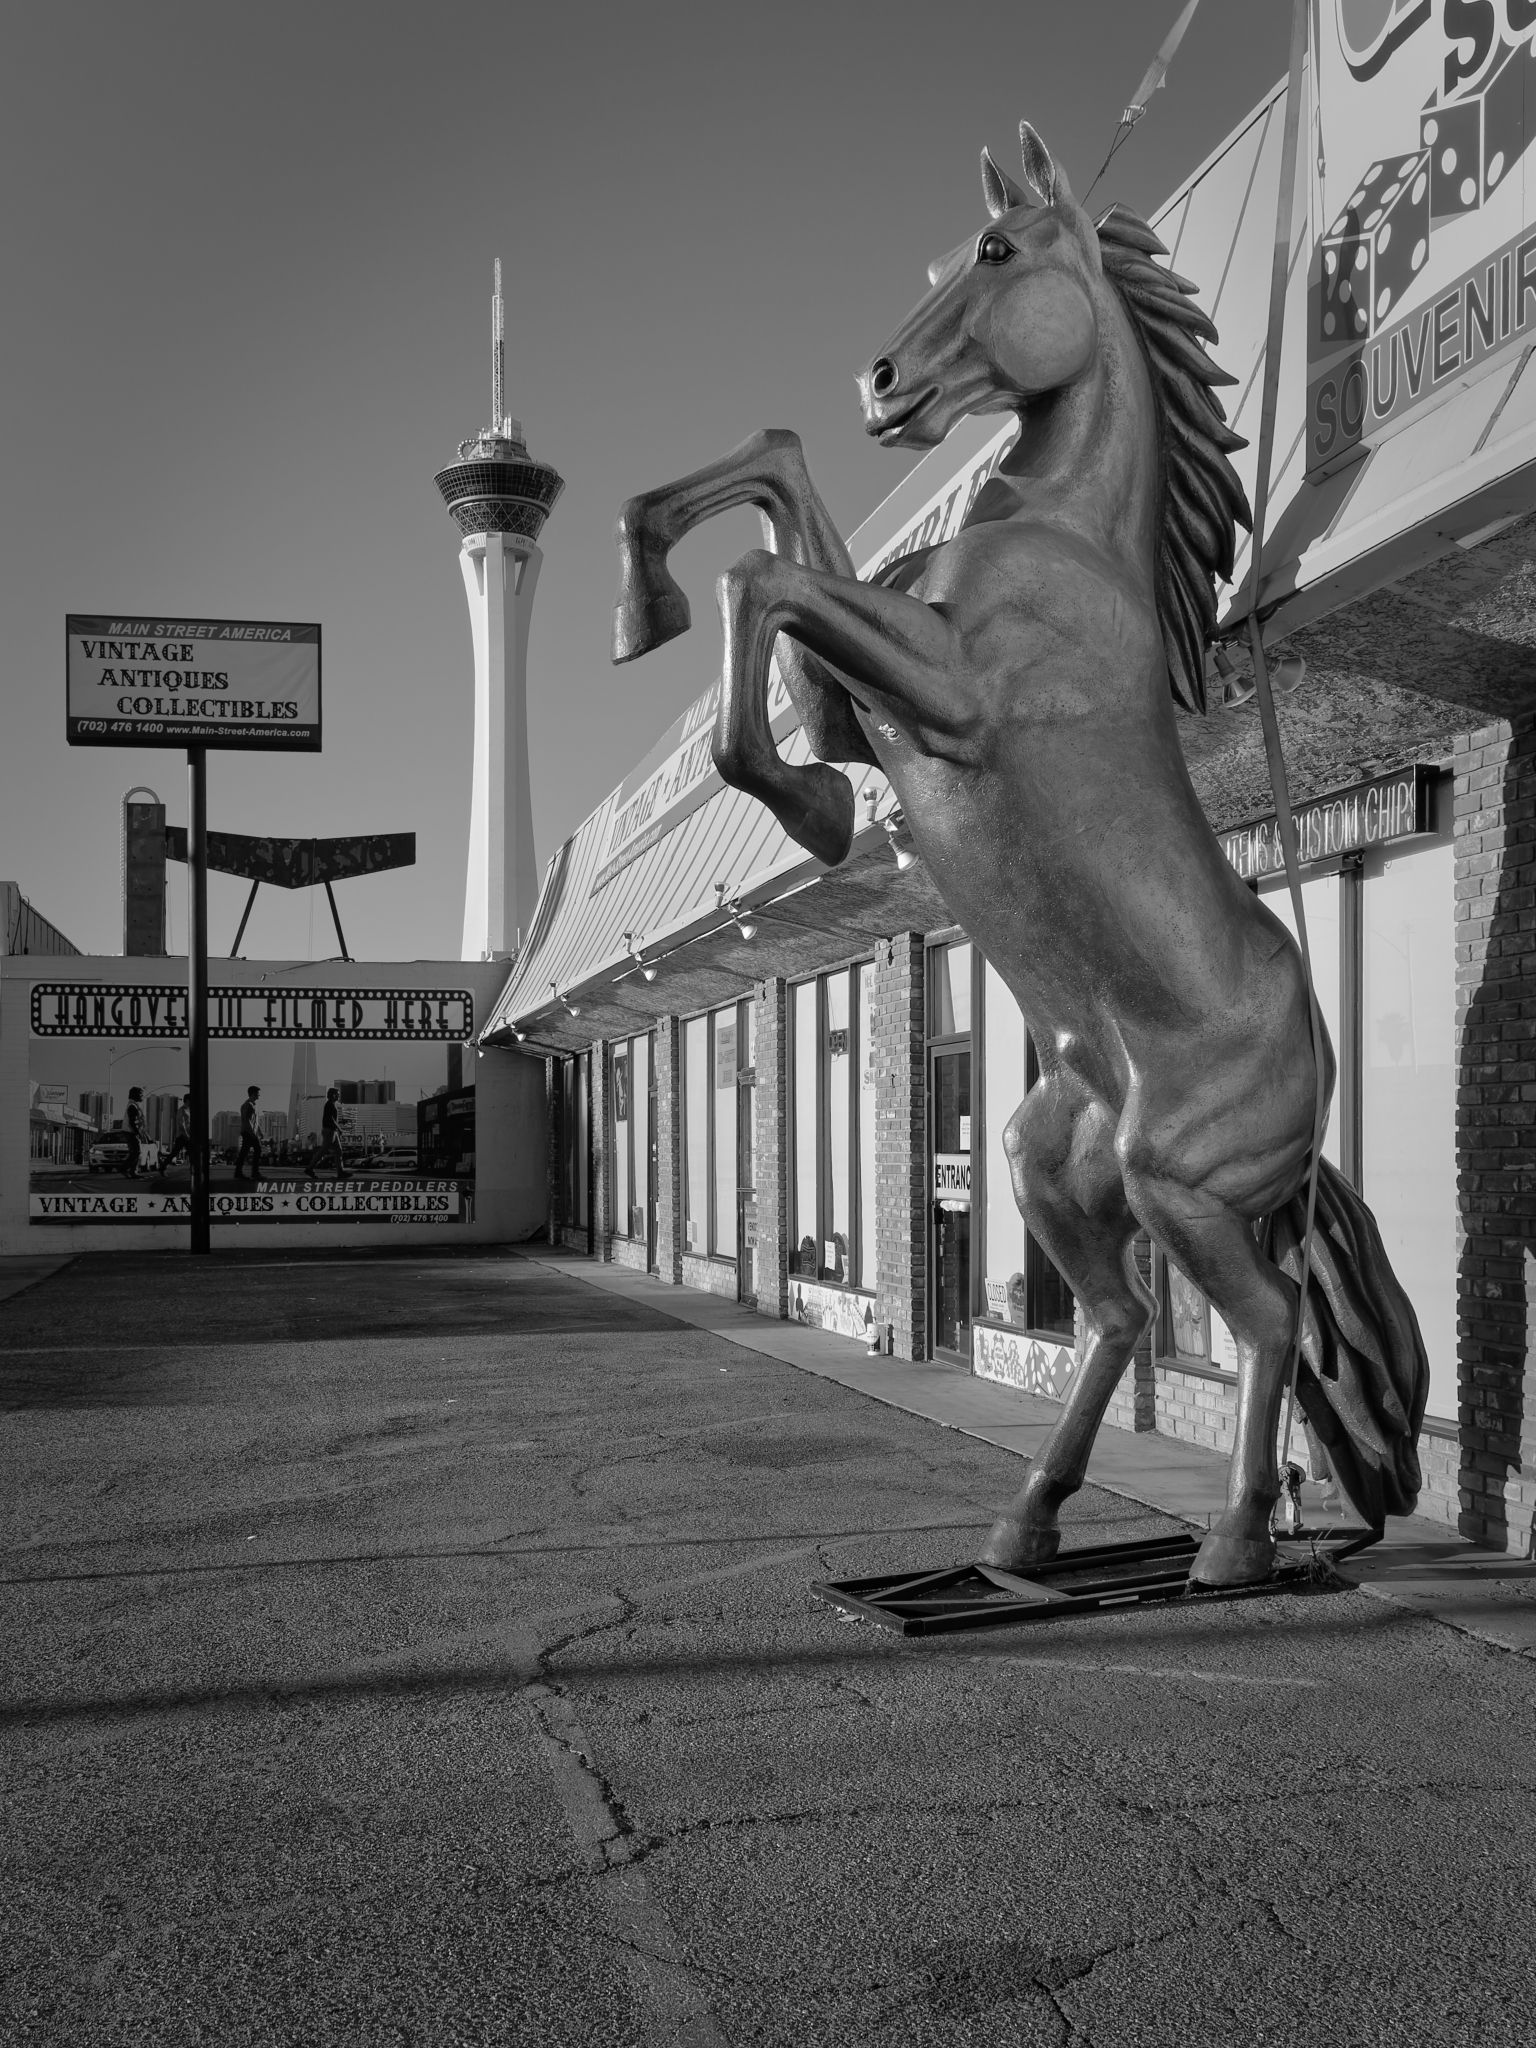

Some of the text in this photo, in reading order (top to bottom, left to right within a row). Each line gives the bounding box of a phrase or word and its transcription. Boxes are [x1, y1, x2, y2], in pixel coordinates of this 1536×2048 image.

[108, 622, 291, 641] MAIN STREET AMERICA
[80, 640, 194, 662] VINTAGE
[97, 668, 229, 692] ANTIQUES
[117, 696, 298, 719] COLLECTIBLES
[77, 720, 310, 738] (702) 476 1400 www.Main-Street-America.com
[607, 772, 665, 859] VINTAGE
[217, 998, 242, 1028] III
[264, 999, 363, 1029] FILMED
[384, 1000, 449, 1029] HERE
[256, 1181, 459, 1193] MAIN STREET PEDDLERS
[935, 1164, 971, 1191] ENTRANC
[40, 1196, 449, 1215] VINTAGE ANIQUES COLLECTIBLES
[390, 1214, 411, 1224] (702)
[429, 1214, 449, 1222] 1400
